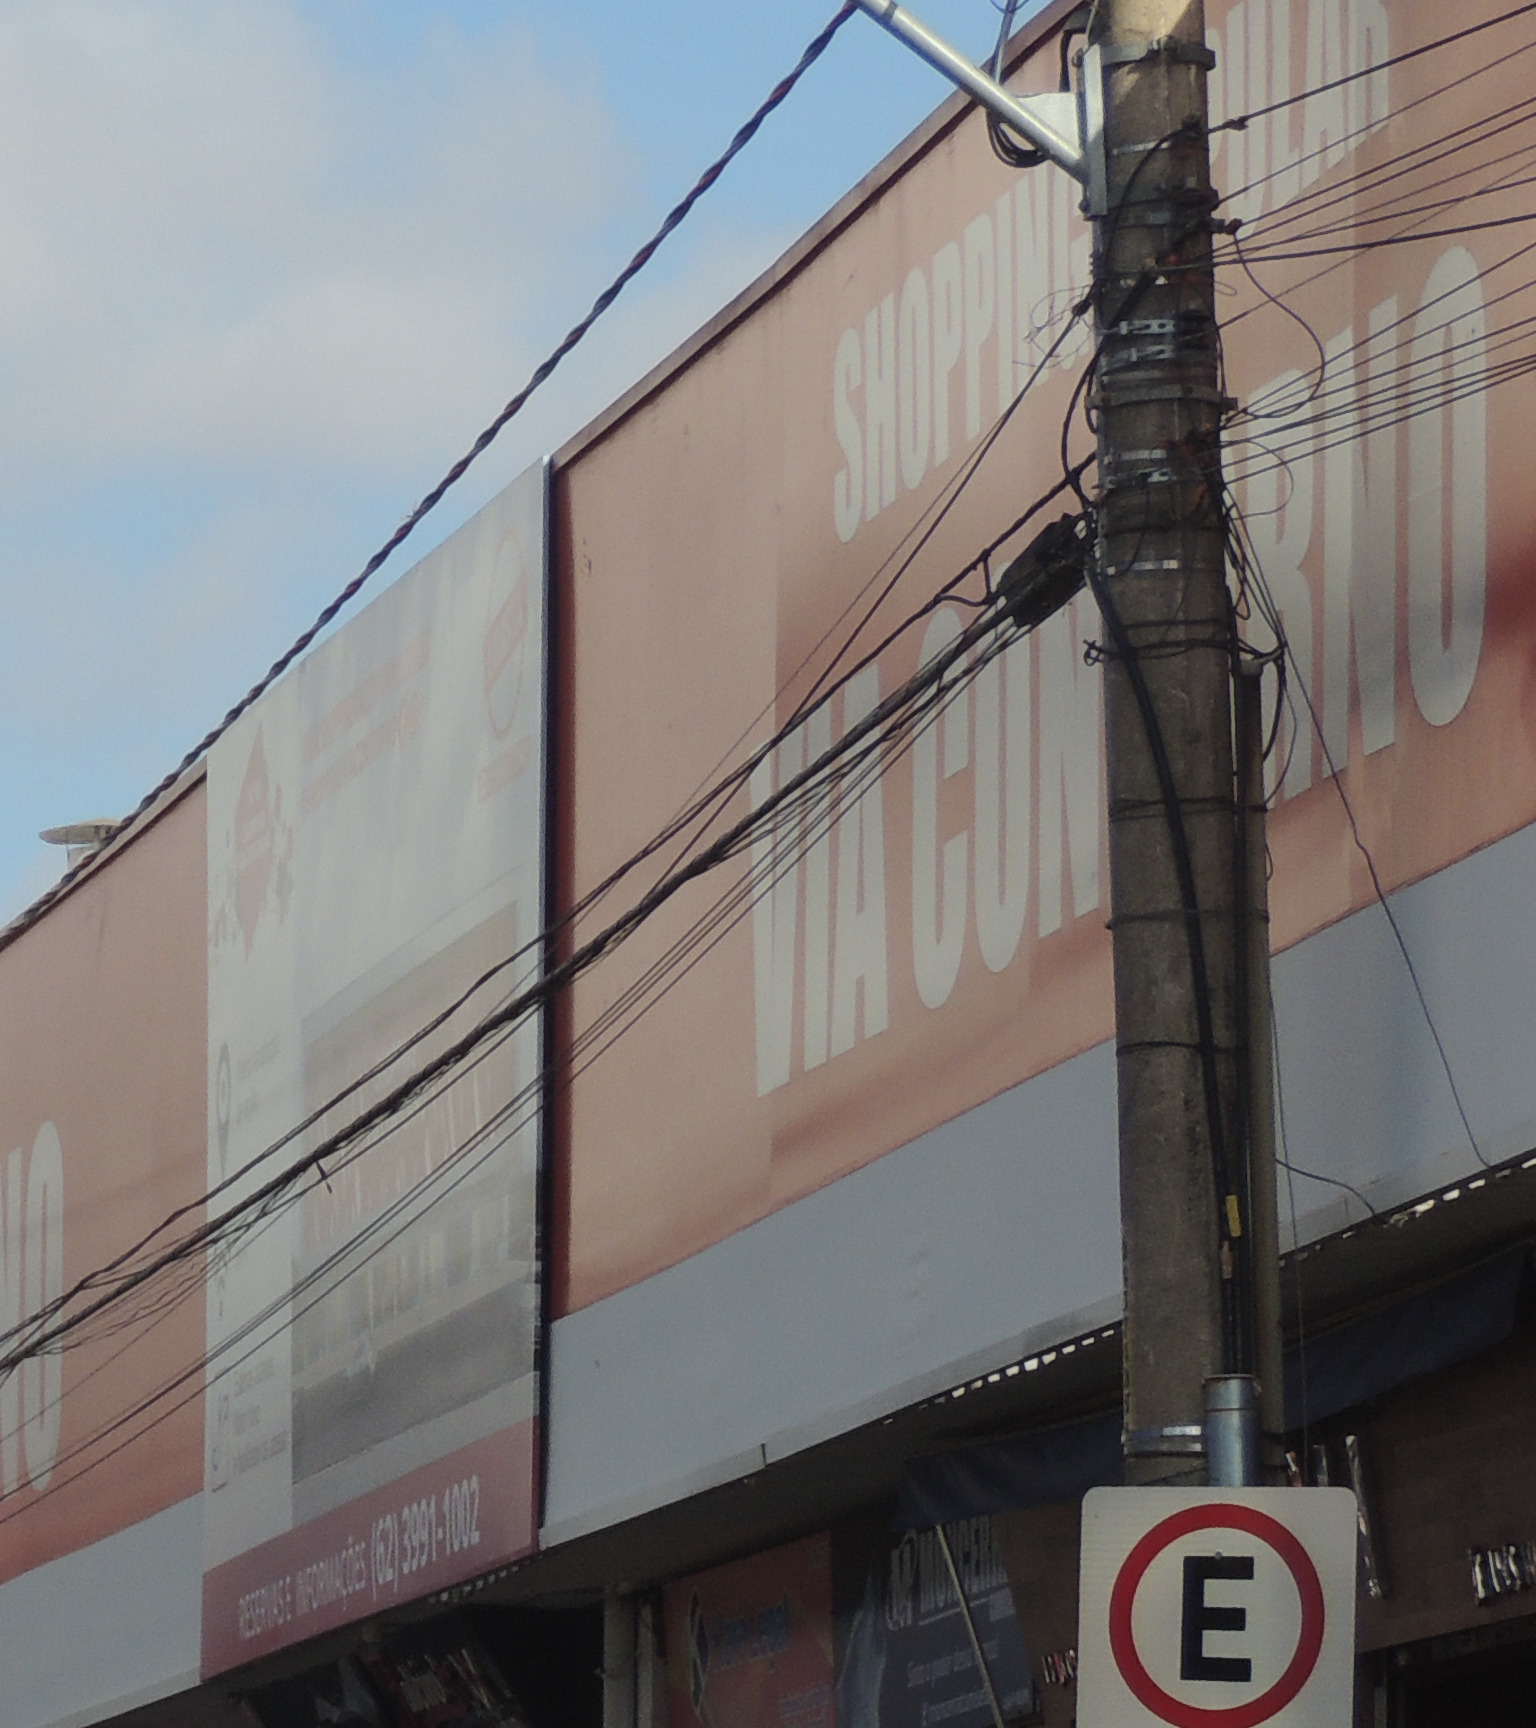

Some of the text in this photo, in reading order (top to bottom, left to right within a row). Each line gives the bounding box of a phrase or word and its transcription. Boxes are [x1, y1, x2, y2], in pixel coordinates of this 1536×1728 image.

[749, 662, 890, 1098] VIA
[371, 1511, 400, 1602] (62)
[402, 1475, 482, 1575] 3991-1002
[1180, 1555, 1256, 1683] E
